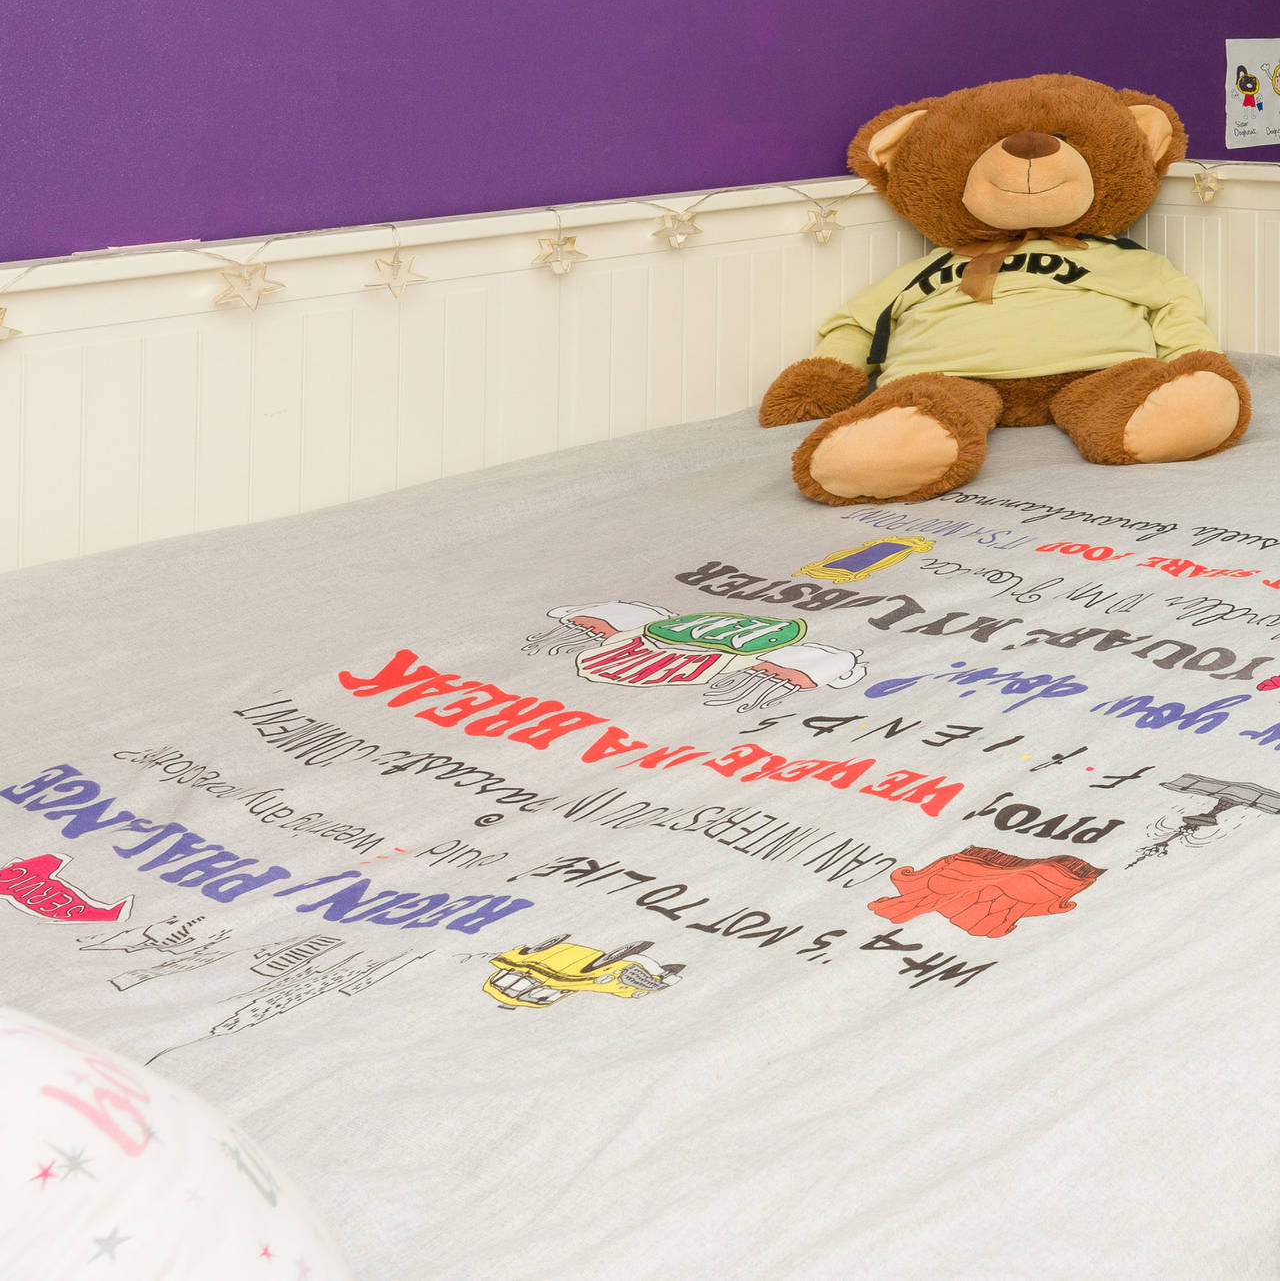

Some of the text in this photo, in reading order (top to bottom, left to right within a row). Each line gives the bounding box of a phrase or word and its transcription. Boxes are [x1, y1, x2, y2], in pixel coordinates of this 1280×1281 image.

[1136, 556, 1261, 579] SHARE
[675, 561, 926, 631] LOBSTER
[1053, 581, 1119, 609] MY
[901, 611, 1024, 643] MY
[1130, 639, 1275, 680] YOU
[338, 649, 611, 750] BREAK
[1090, 693, 1251, 735] you
[581, 726, 649, 764] A
[702, 742, 877, 790] WERE
[238, 789, 293, 824] any
[859, 769, 965, 818] WE
[803, 837, 897, 888] CAN
[273, 870, 535, 934] REGIN
[636, 884, 709, 920] TO
[687, 907, 804, 948] NOT
